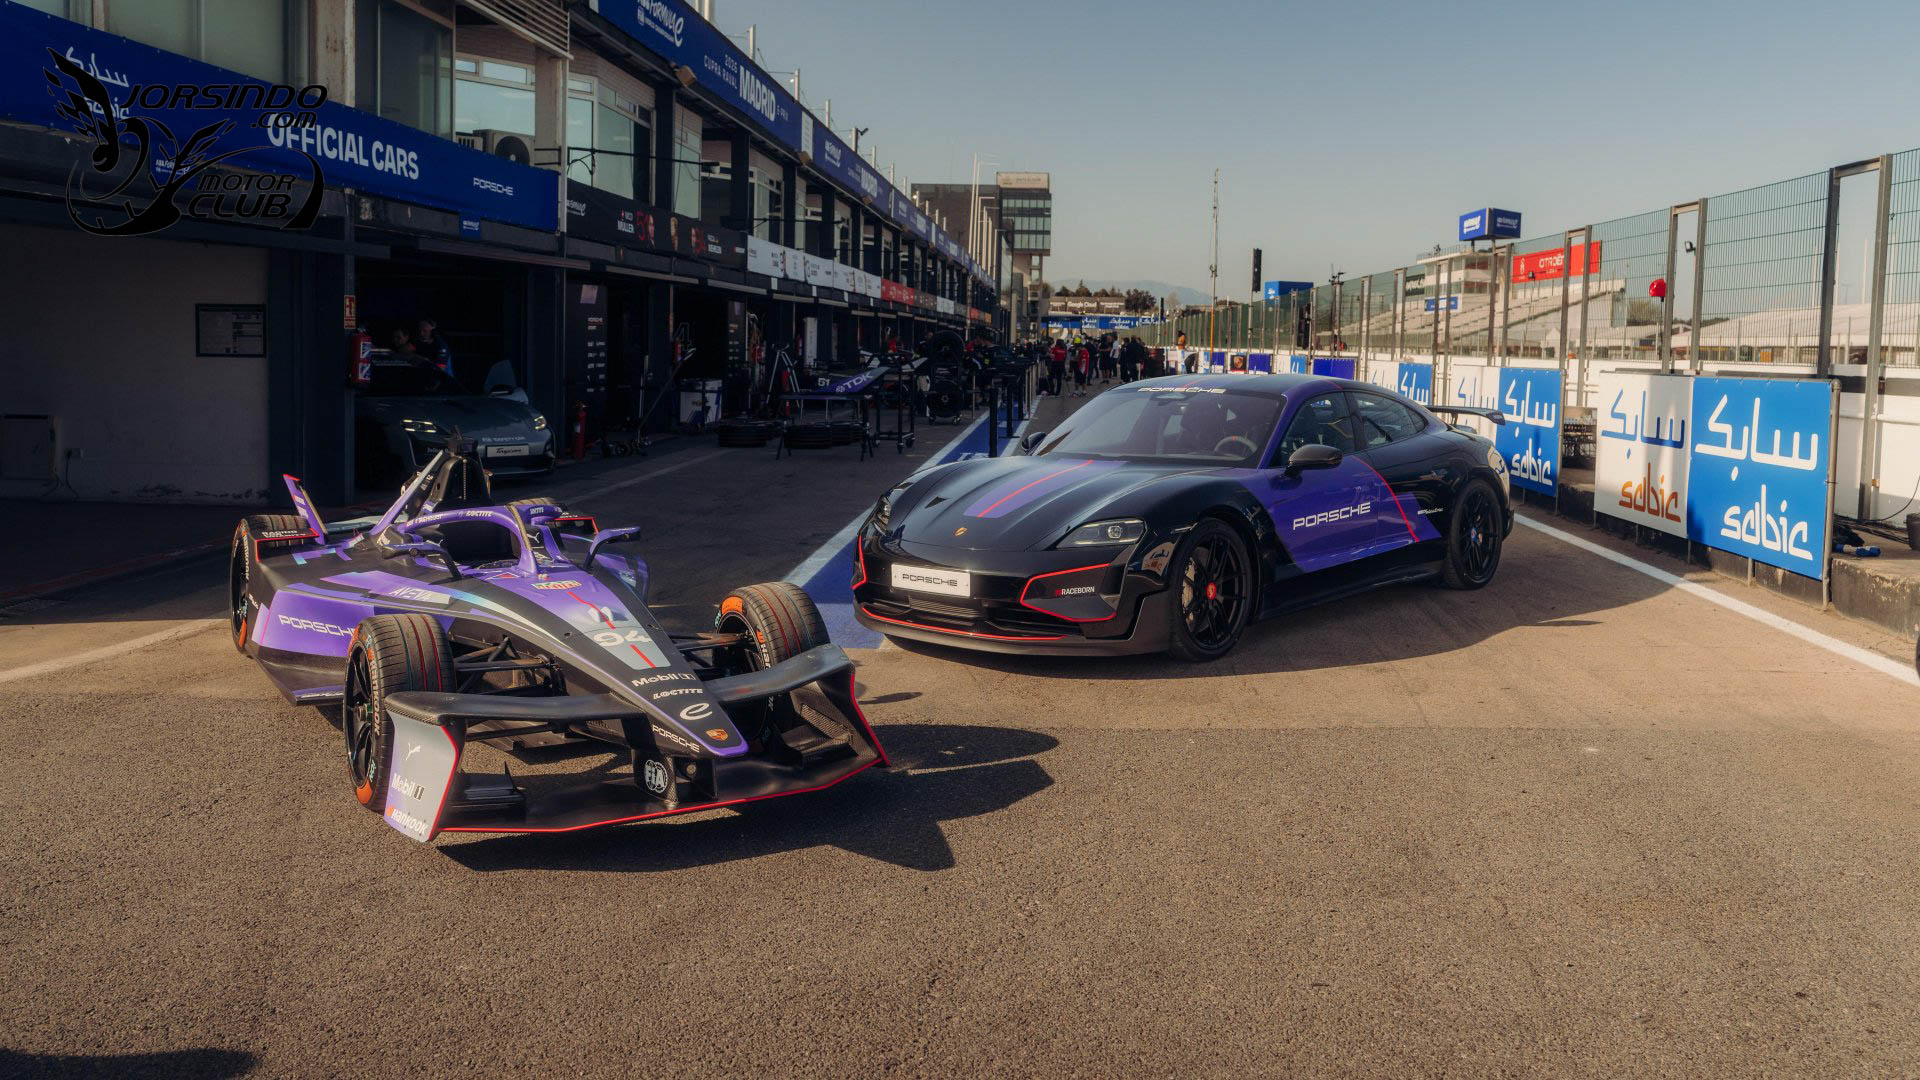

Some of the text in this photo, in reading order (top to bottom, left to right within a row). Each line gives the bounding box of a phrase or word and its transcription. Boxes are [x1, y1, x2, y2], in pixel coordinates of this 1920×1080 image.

[704, 55, 738, 89] CUPRA RAVAL
[725, 54, 738, 73] 2026
[739, 65, 777, 122] MADRID
[267, 113, 419, 180] OFFICIAL CARS
[473, 177, 514, 196] PORSCHE
[1067, 301, 1083, 309] Google
[817, 377, 830, 387] 51
[842, 372, 874, 389] TDK
[1138, 386, 1227, 394] PORSCHE
[1601, 388, 1686, 459] سابك
[1695, 394, 1819, 482] سابك
[1511, 437, 1553, 487] sabic
[1619, 462, 1682, 523] sabic
[1292, 502, 1372, 531] PORSCHE
[1720, 484, 1814, 561] sabic
[902, 573, 958, 587] PORSCHE
[1061, 586, 1096, 596] RACEBORN
[278, 614, 355, 637] PORSCH
[631, 673, 680, 687] Mobil
[653, 687, 703, 700] LOCTITE
[652, 724, 700, 753] PORSCHE
[391, 772, 416, 798] Mobil
